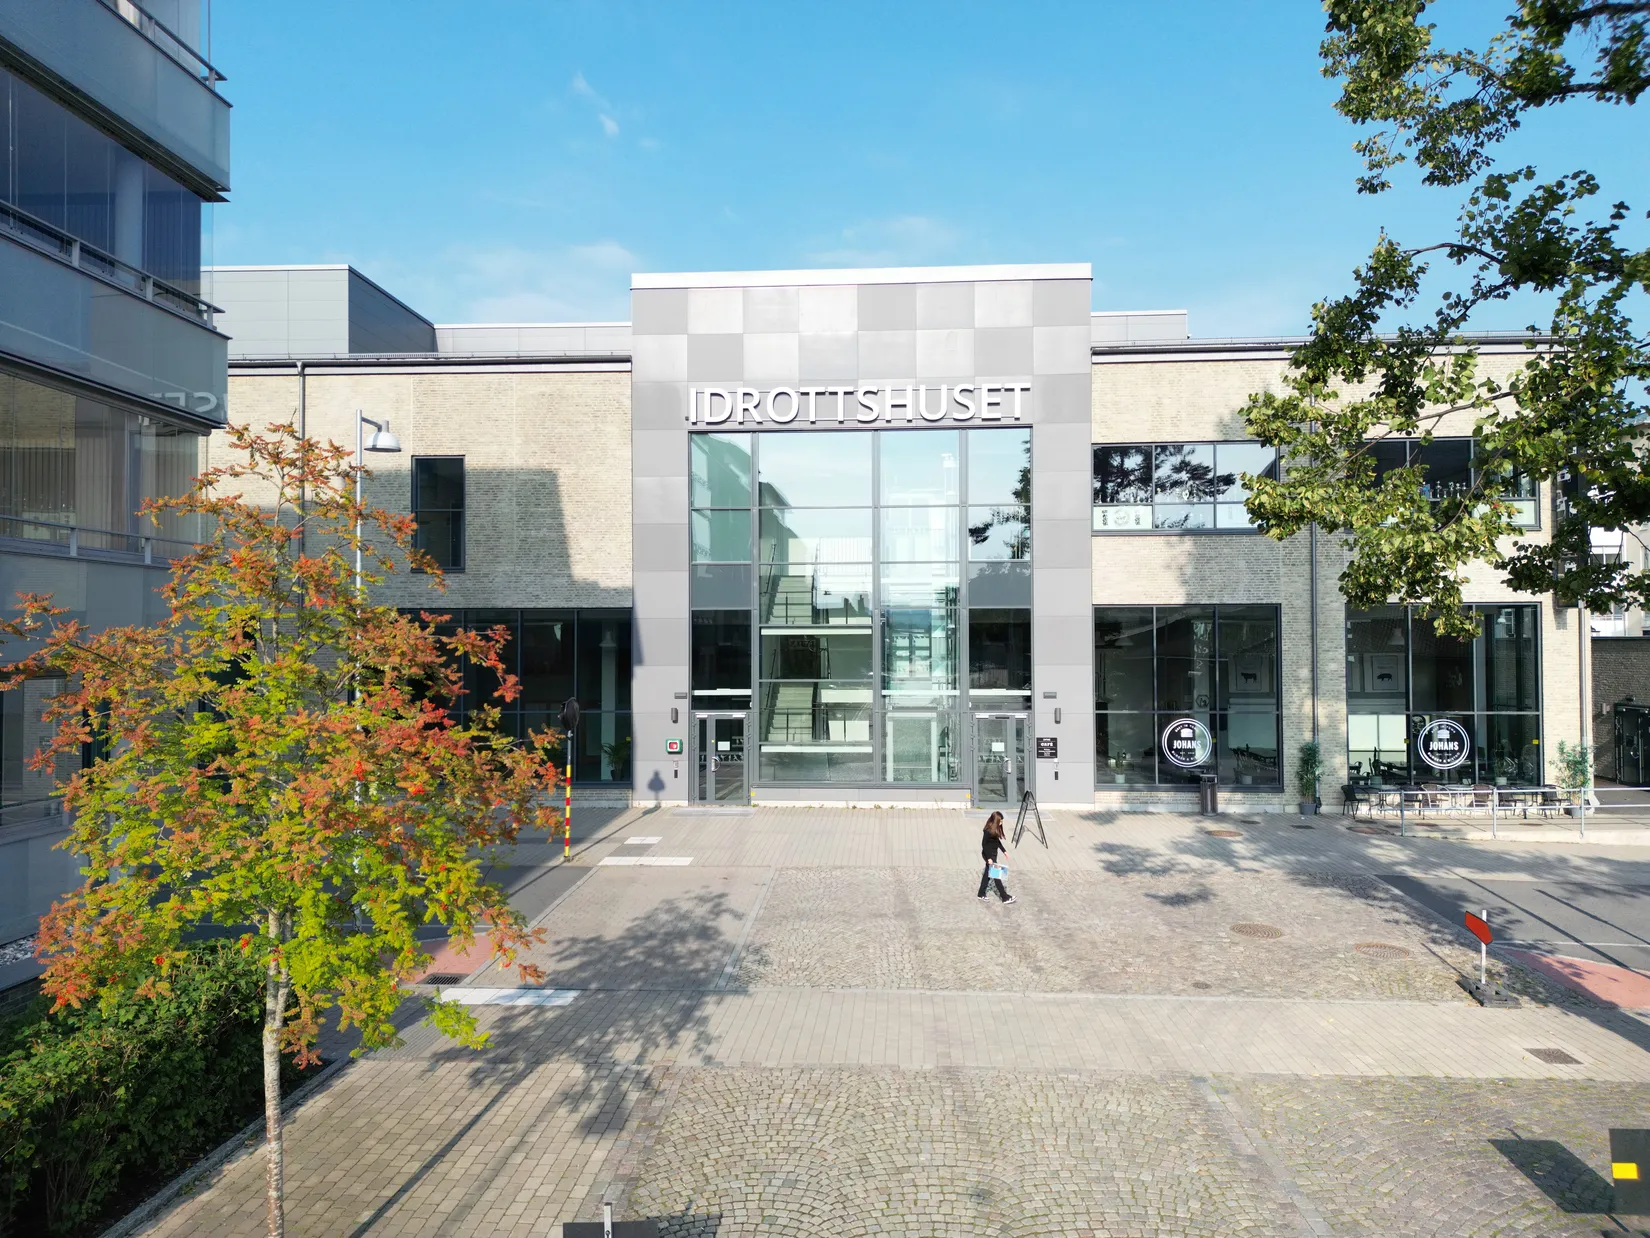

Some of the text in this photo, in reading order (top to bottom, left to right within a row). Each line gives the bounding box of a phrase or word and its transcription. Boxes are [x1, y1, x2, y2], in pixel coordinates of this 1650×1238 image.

[689, 382, 1031, 424] IDROTTSHUSET
[1173, 740, 1201, 749] JOHANS
[1429, 741, 1459, 750] JOHANS
